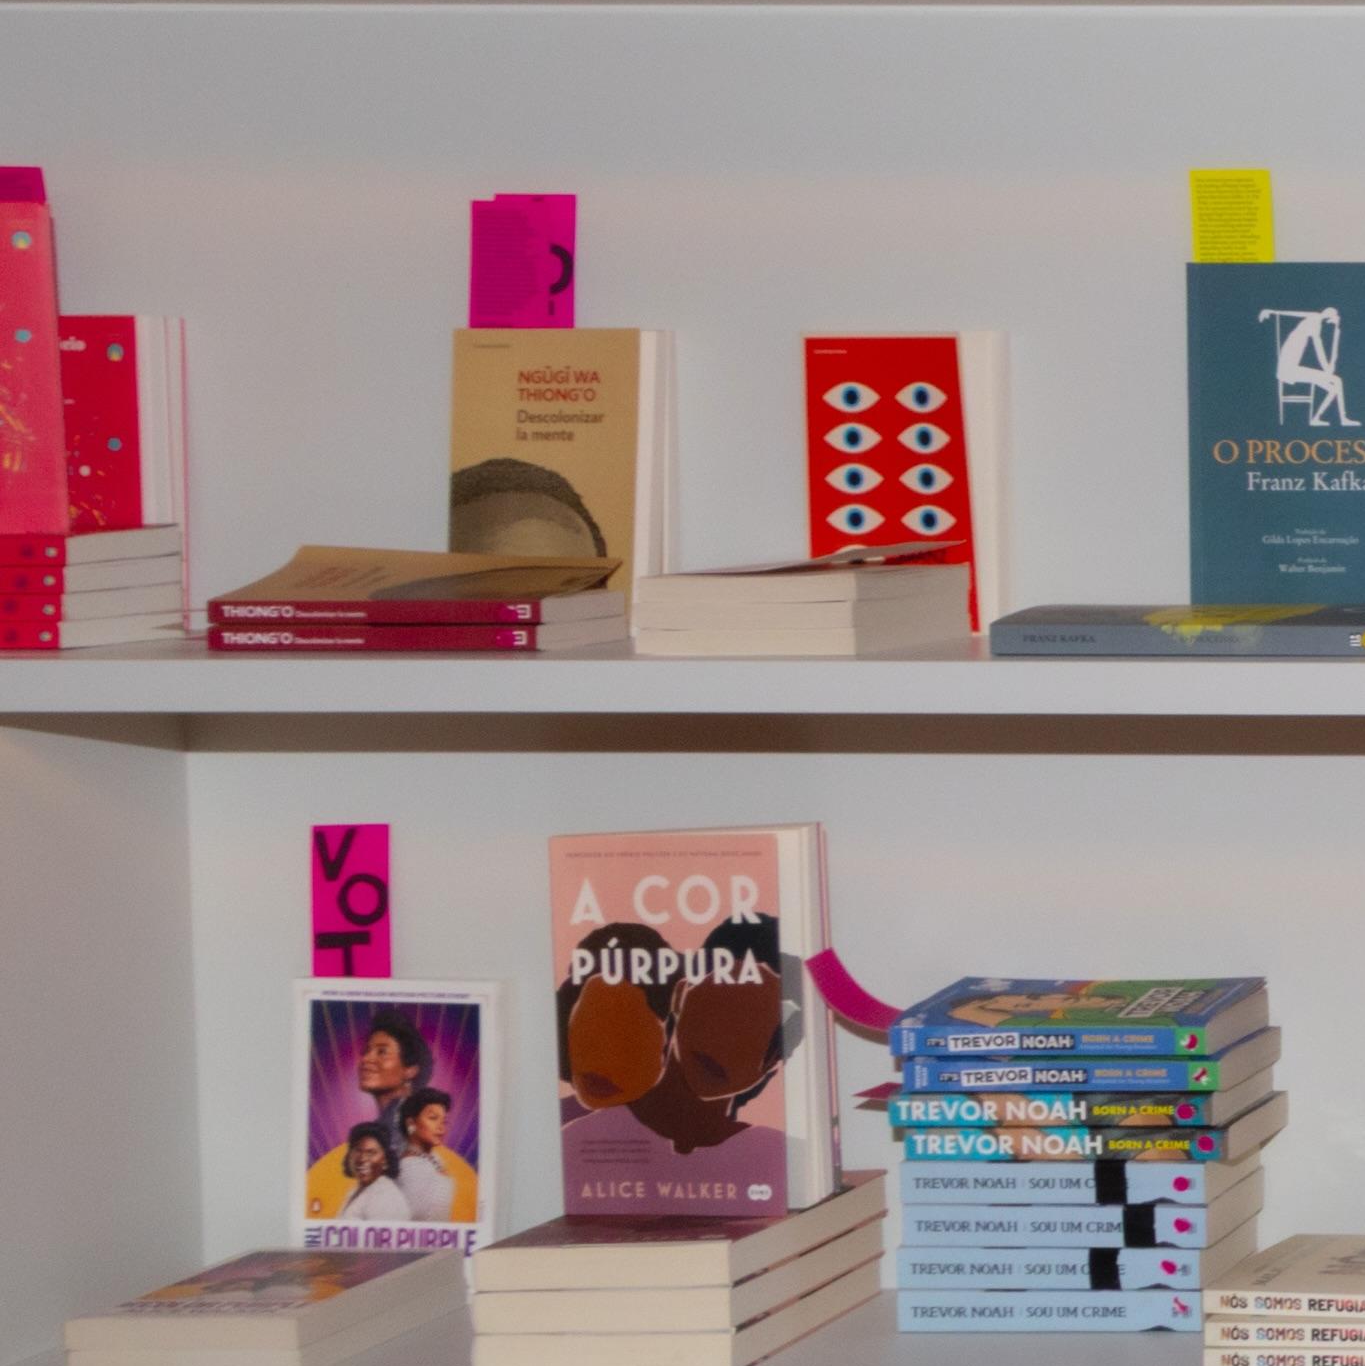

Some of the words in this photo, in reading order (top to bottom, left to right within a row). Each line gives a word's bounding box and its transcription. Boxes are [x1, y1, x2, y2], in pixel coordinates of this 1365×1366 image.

[1213, 440, 1240, 465] O
[1246, 471, 1307, 492] Franz
[569, 876, 605, 925] A
[633, 875, 761, 926] COR
[572, 938, 764, 986] PÚRPURA
[896, 1100, 998, 1121] TREVOR
[1006, 1100, 1086, 1120] NOAH
[1092, 1106, 1118, 1117] BORN
[1121, 1106, 1131, 1116] A
[1133, 1105, 1175, 1117] CRIME
[581, 1180, 646, 1200] ALICE
[657, 1181, 738, 1200] WALKER
